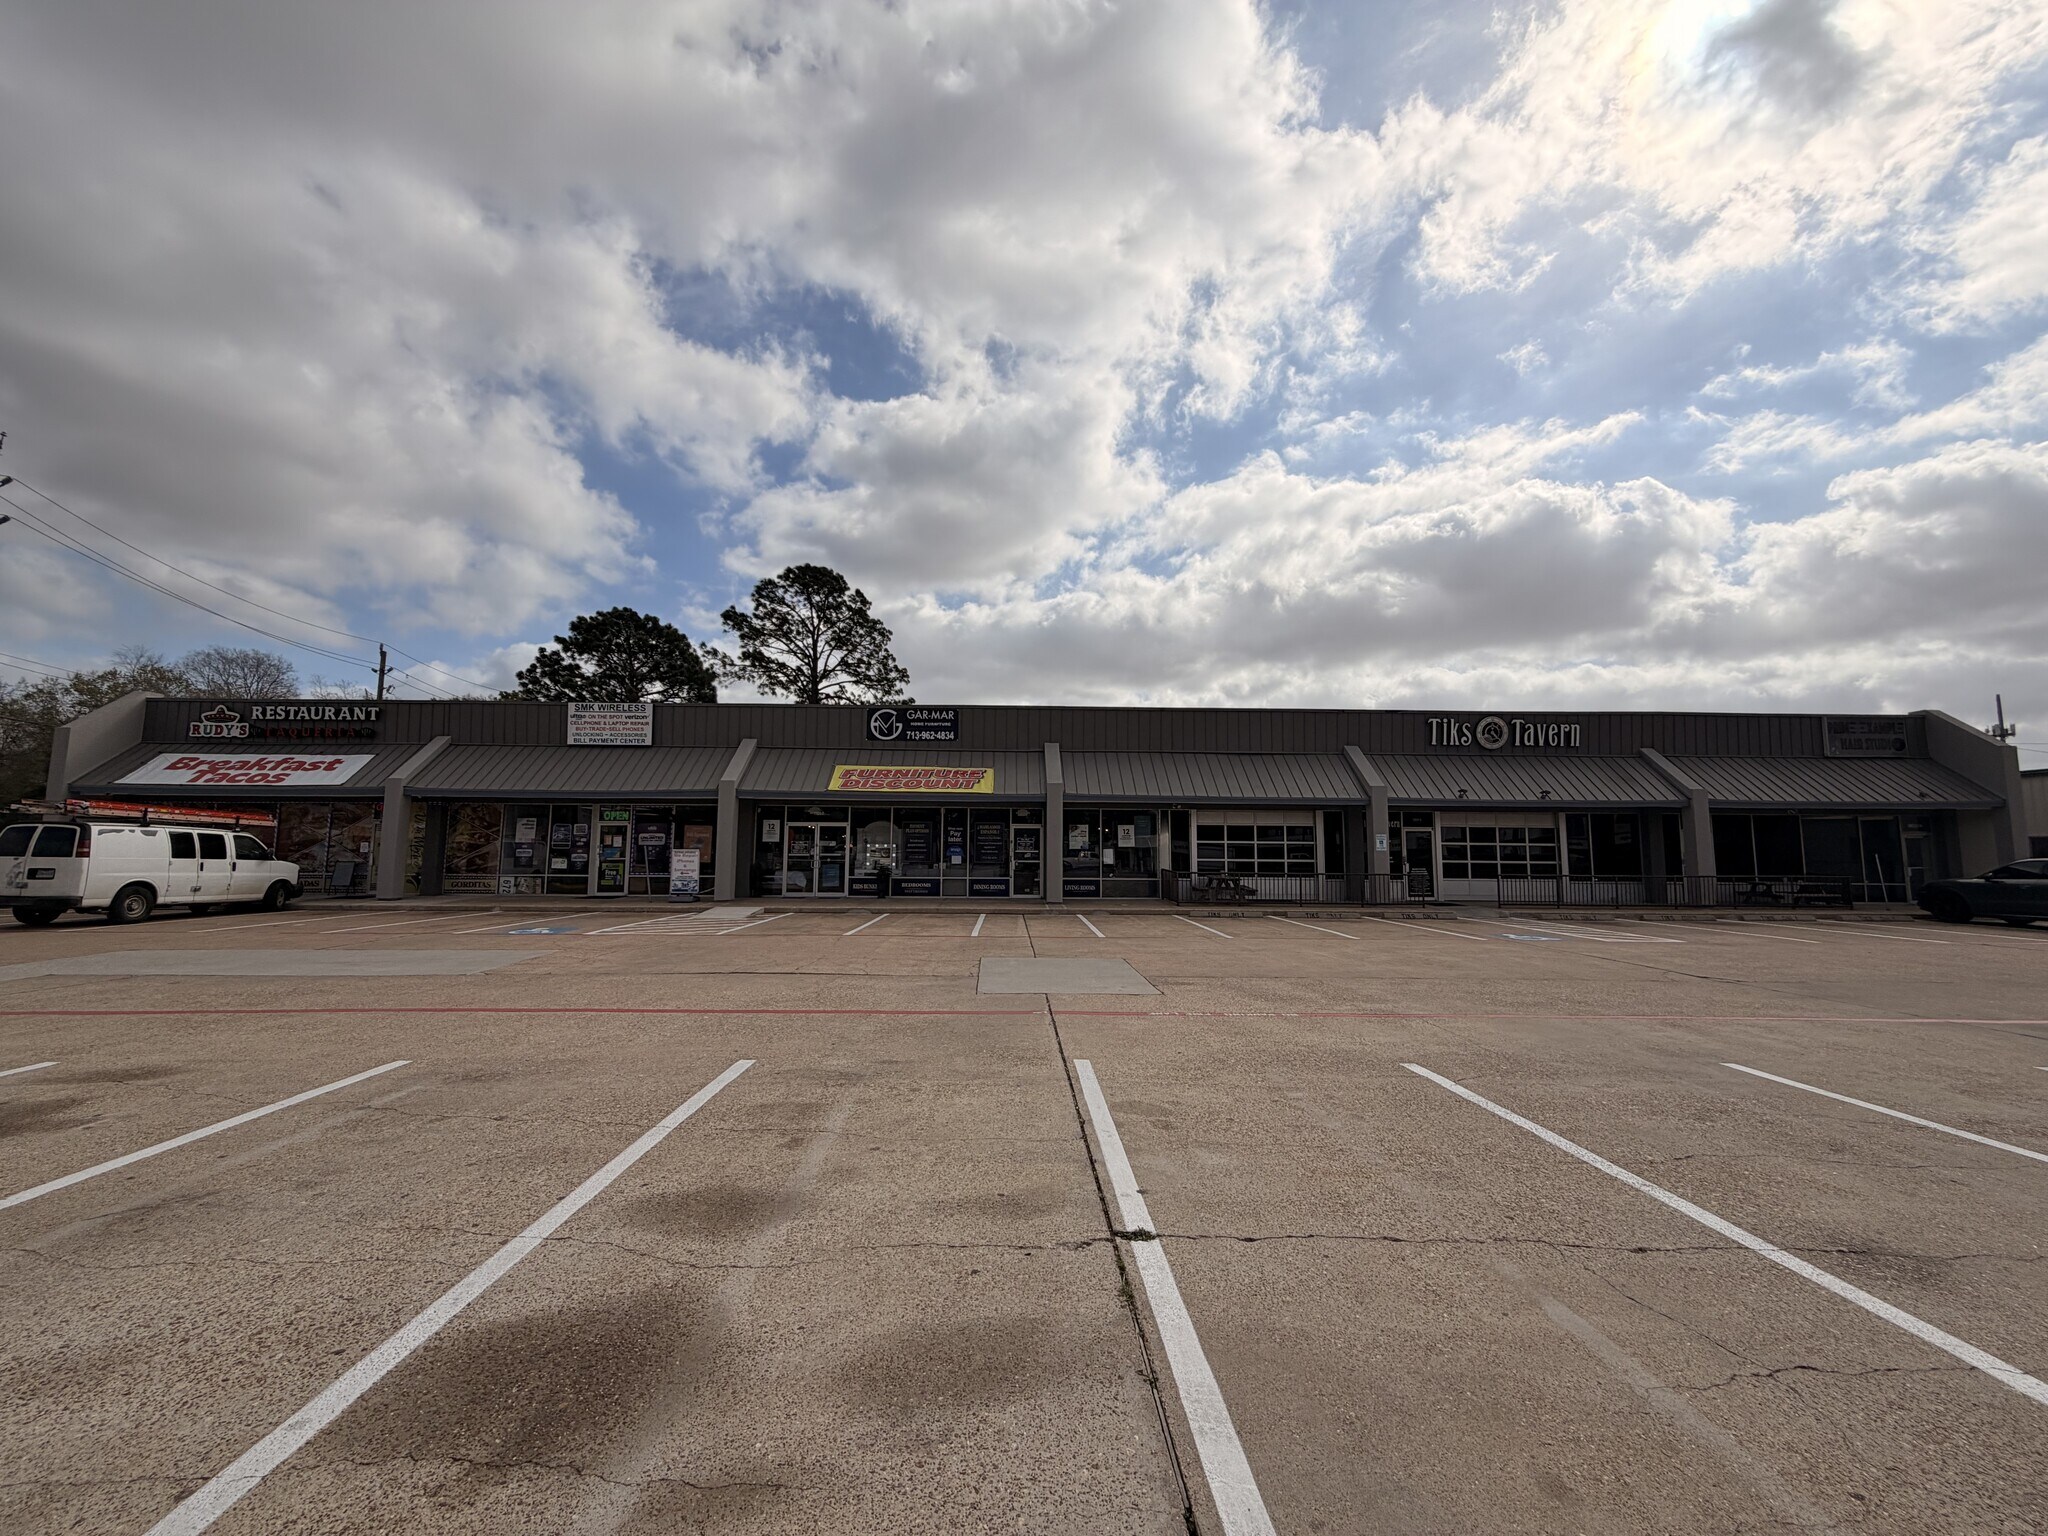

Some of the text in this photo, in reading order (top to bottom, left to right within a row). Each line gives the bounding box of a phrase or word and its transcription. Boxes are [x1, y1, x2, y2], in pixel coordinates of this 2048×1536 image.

[251, 706, 380, 720] RESTAURANT
[598, 704, 647, 712] WIRELESS
[906, 710, 954, 720] GAR-MAR
[190, 723, 248, 736] RUDY'S
[265, 727, 357, 738] TAQUERIA
[1428, 718, 1473, 746] Tiks
[1511, 719, 1581, 747] Tavern
[906, 731, 955, 740] 713-962-4834
[164, 756, 345, 772] Breakfast
[186, 769, 292, 784] Tacos
[839, 768, 987, 780] FURNITURE
[838, 778, 981, 789] DISCOUNT
[603, 810, 629, 820] OPEN
[950, 830, 962, 838] Pay
